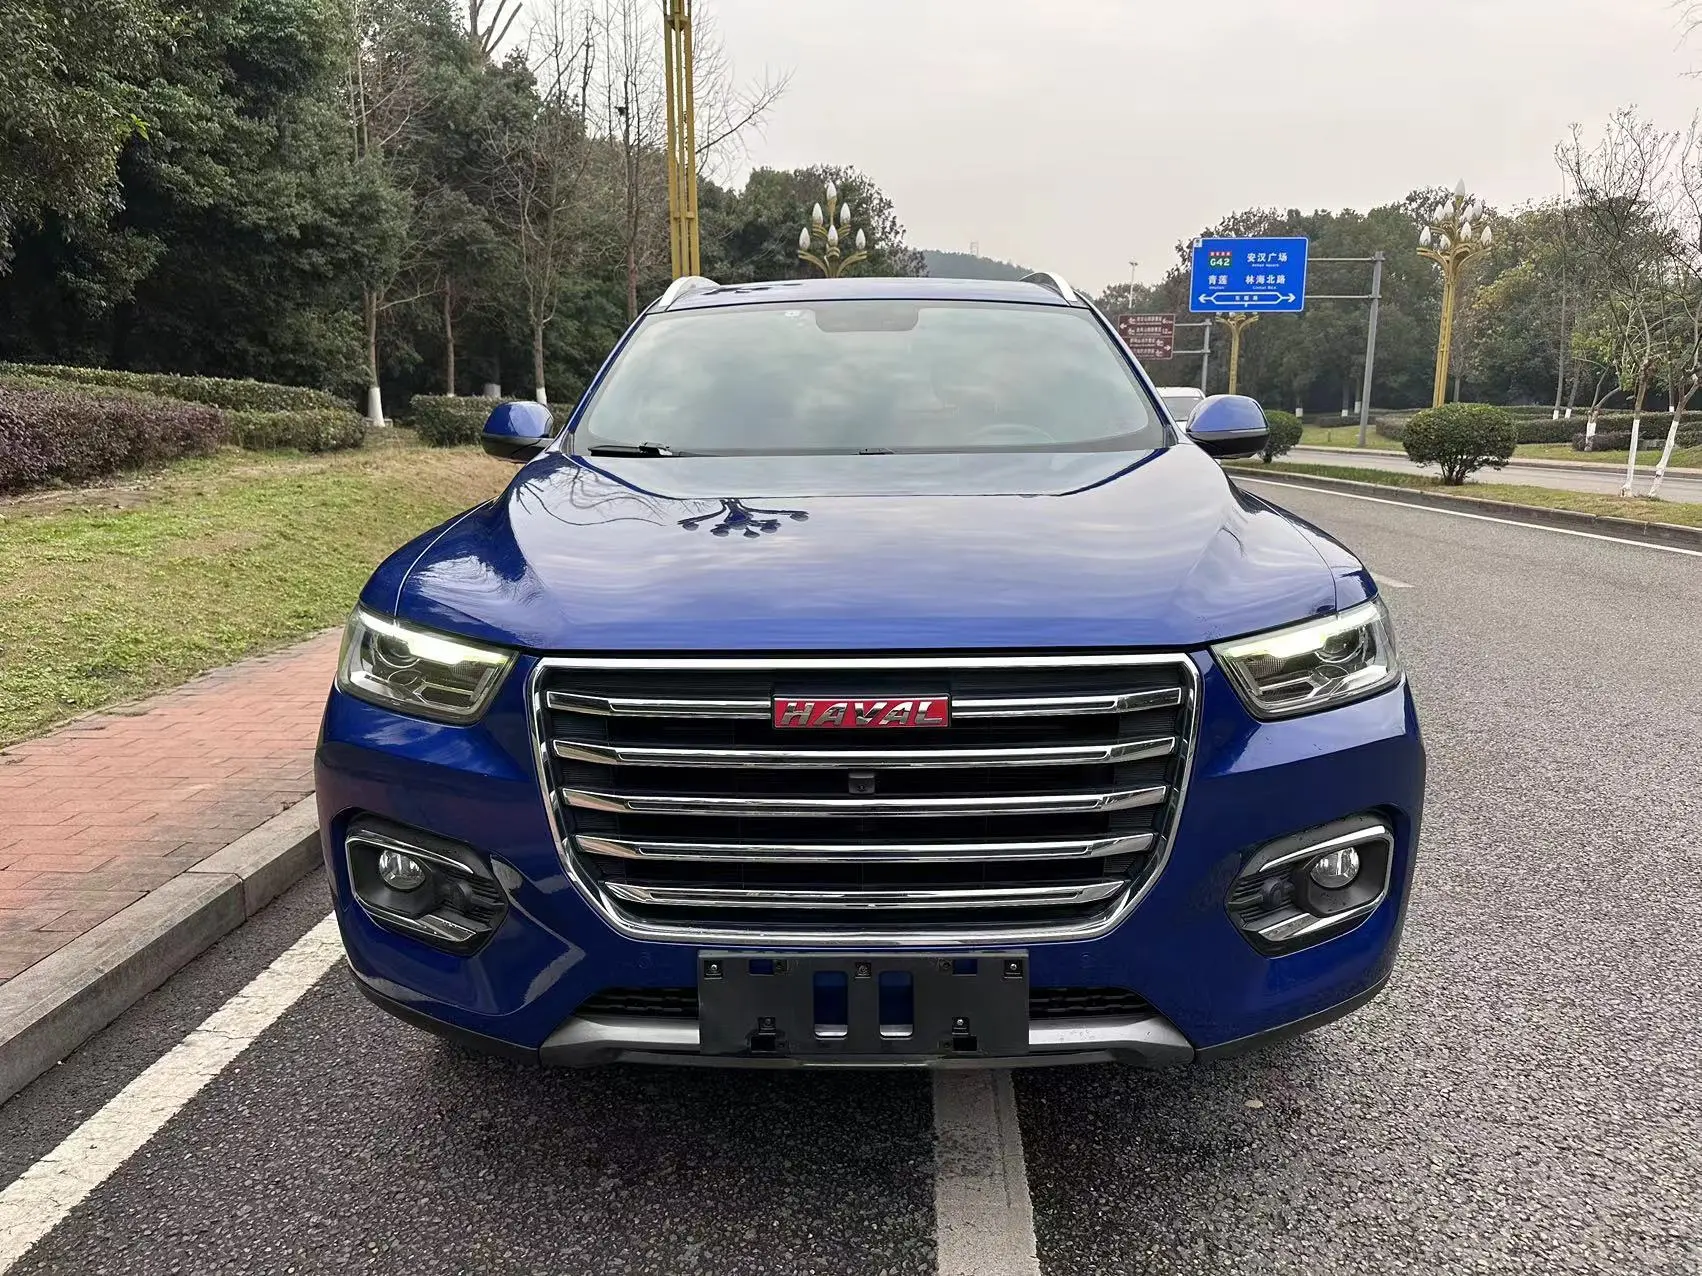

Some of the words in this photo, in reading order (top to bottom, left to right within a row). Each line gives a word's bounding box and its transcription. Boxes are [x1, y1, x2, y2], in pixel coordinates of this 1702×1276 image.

[1210, 258, 1230, 266] G42
[1247, 252, 1288, 263] 安汉广场
[1245, 275, 1286, 285] 林海北路
[781, 701, 943, 726] HAVAL
